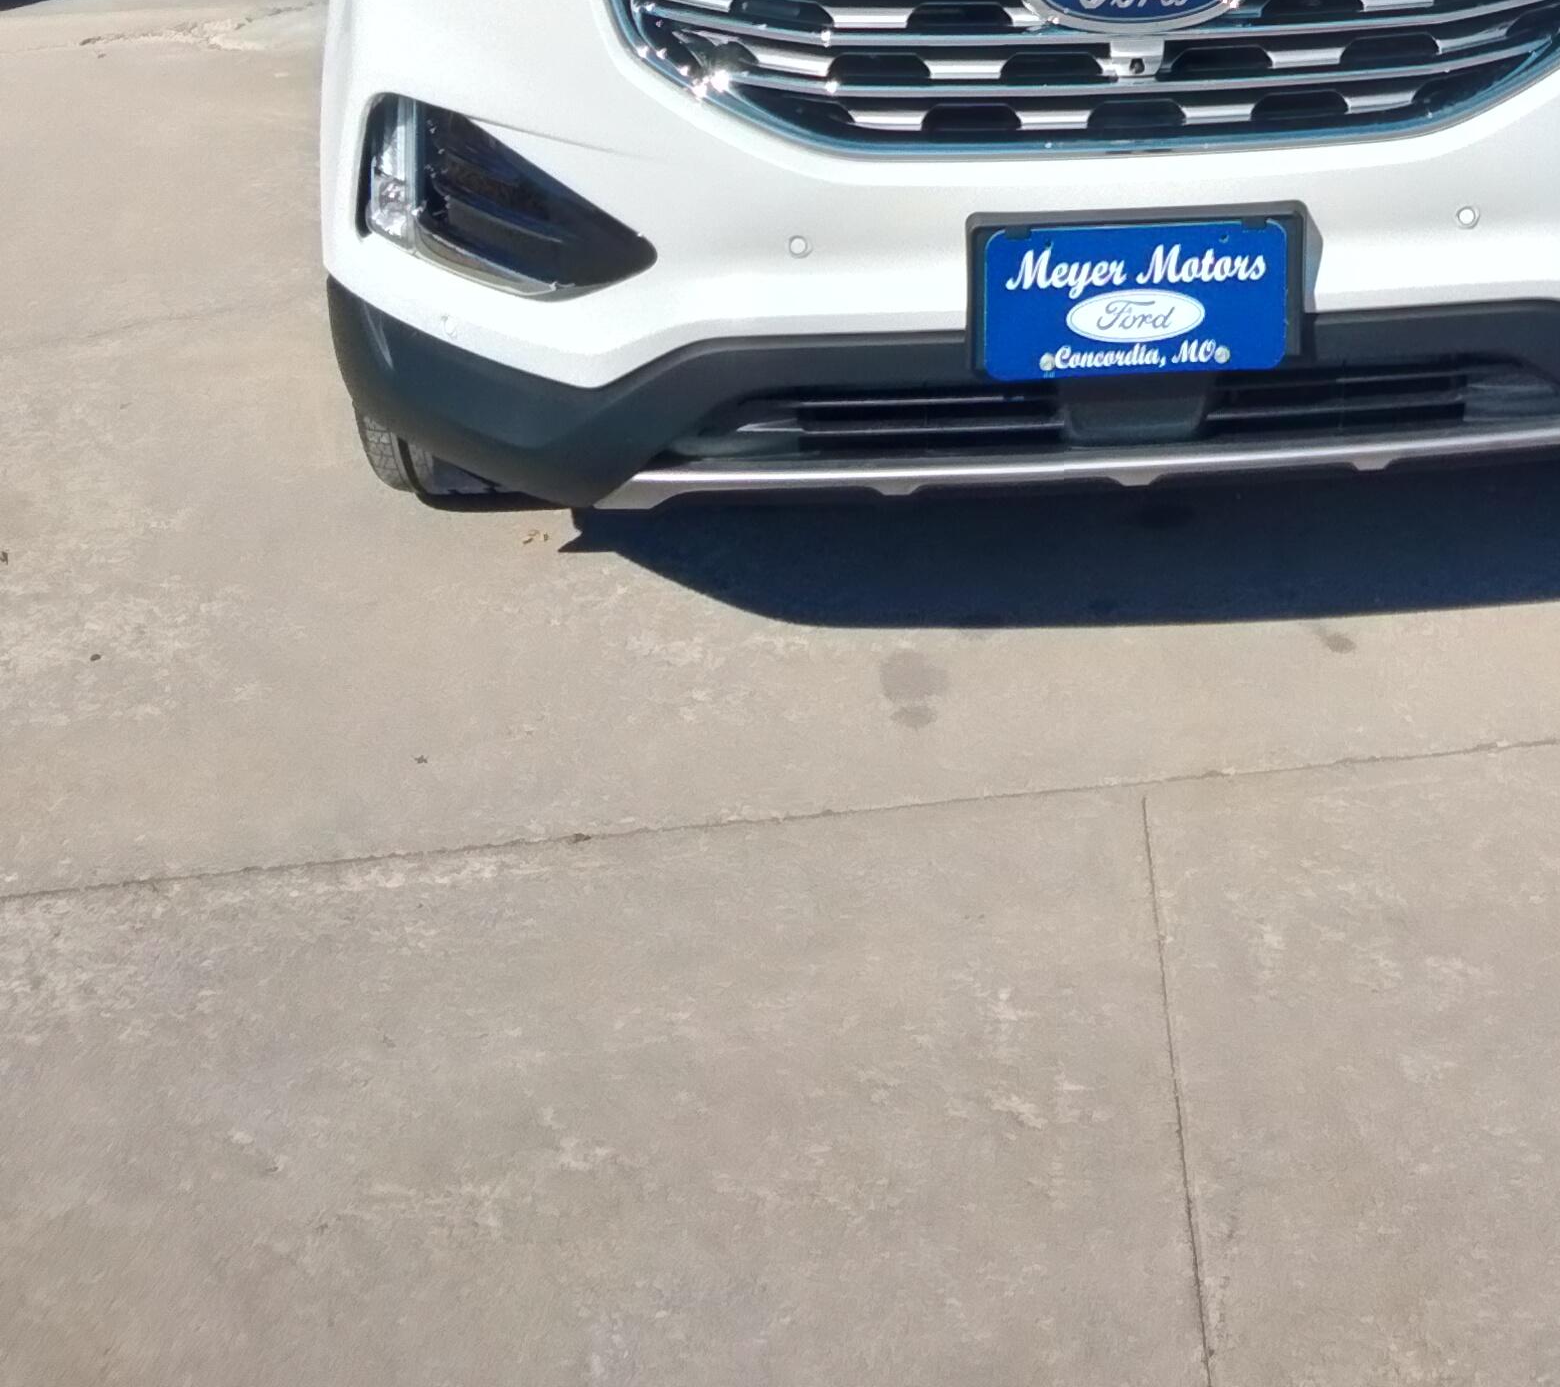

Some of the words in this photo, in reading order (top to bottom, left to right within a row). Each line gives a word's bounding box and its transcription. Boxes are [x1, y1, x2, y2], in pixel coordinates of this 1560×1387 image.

[1005, 248, 1127, 299] Meyer
[1136, 244, 1266, 282] Motors
[1096, 299, 1174, 331] Ford
[1055, 342, 1166, 369] Concordia,
[1171, 339, 1217, 364] MO
